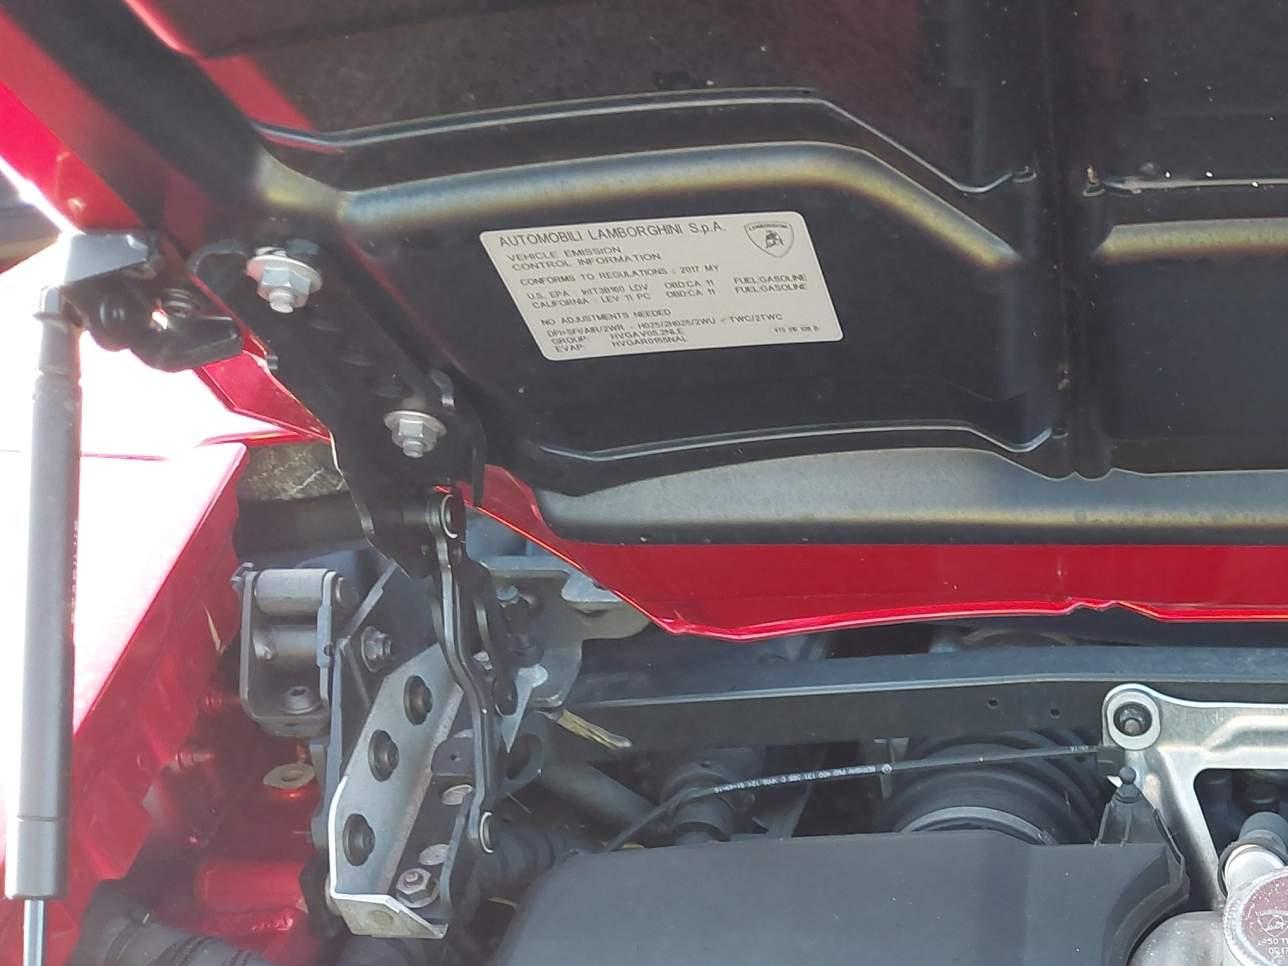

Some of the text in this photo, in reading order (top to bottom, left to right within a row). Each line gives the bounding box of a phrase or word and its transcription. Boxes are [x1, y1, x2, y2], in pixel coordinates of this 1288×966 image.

[499, 230, 583, 248] AUTOMOBILI
[587, 224, 683, 241] LAMBORGHINI
[507, 247, 621, 262] VEHICLE EMISSION
[511, 253, 661, 271] CONTROL INFORMATION
[520, 275, 576, 286] CONFORMS
[580, 273, 596, 281] TO
[599, 267, 668, 280] REGULATIONS
[679, 264, 700, 274] 2017
[704, 263, 720, 271] MY
[531, 296, 590, 309] CALIFORNIA
[600, 294, 619, 304] LEV
[549, 289, 570, 299] EPA
[561, 311, 629, 324] ADJUSTMENTS
[633, 308, 672, 319] NEEDED
